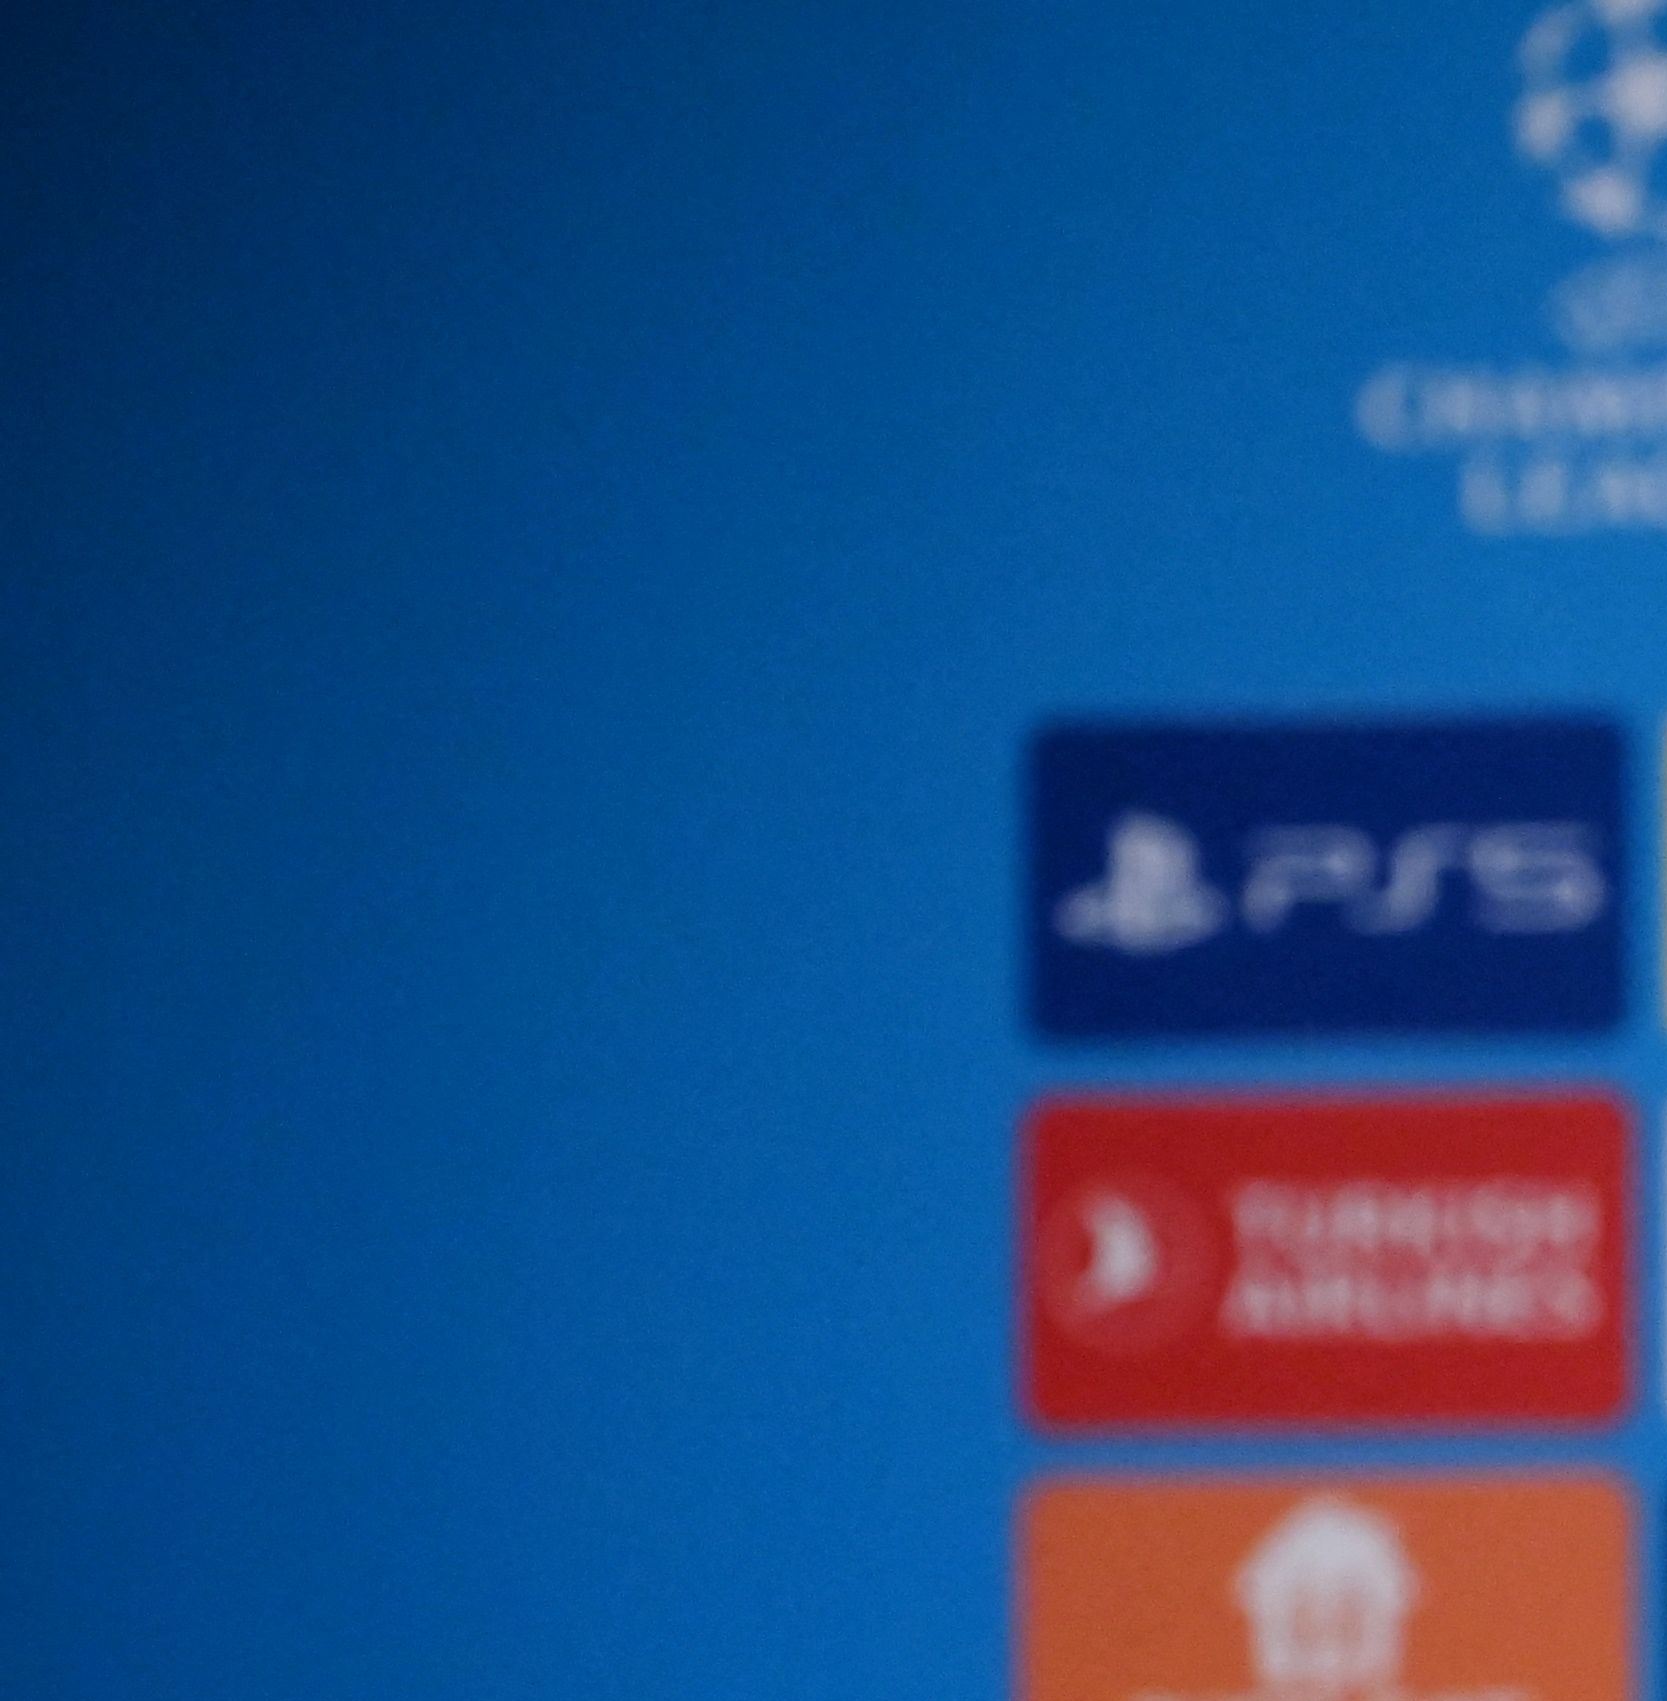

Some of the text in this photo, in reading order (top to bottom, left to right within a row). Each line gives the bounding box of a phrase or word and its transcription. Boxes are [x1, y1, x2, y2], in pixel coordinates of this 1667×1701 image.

[1240, 825, 1604, 935] PS5
[1230, 1179, 1600, 1246] TURKISH
[1222, 1272, 1603, 1342] AIRLINES
